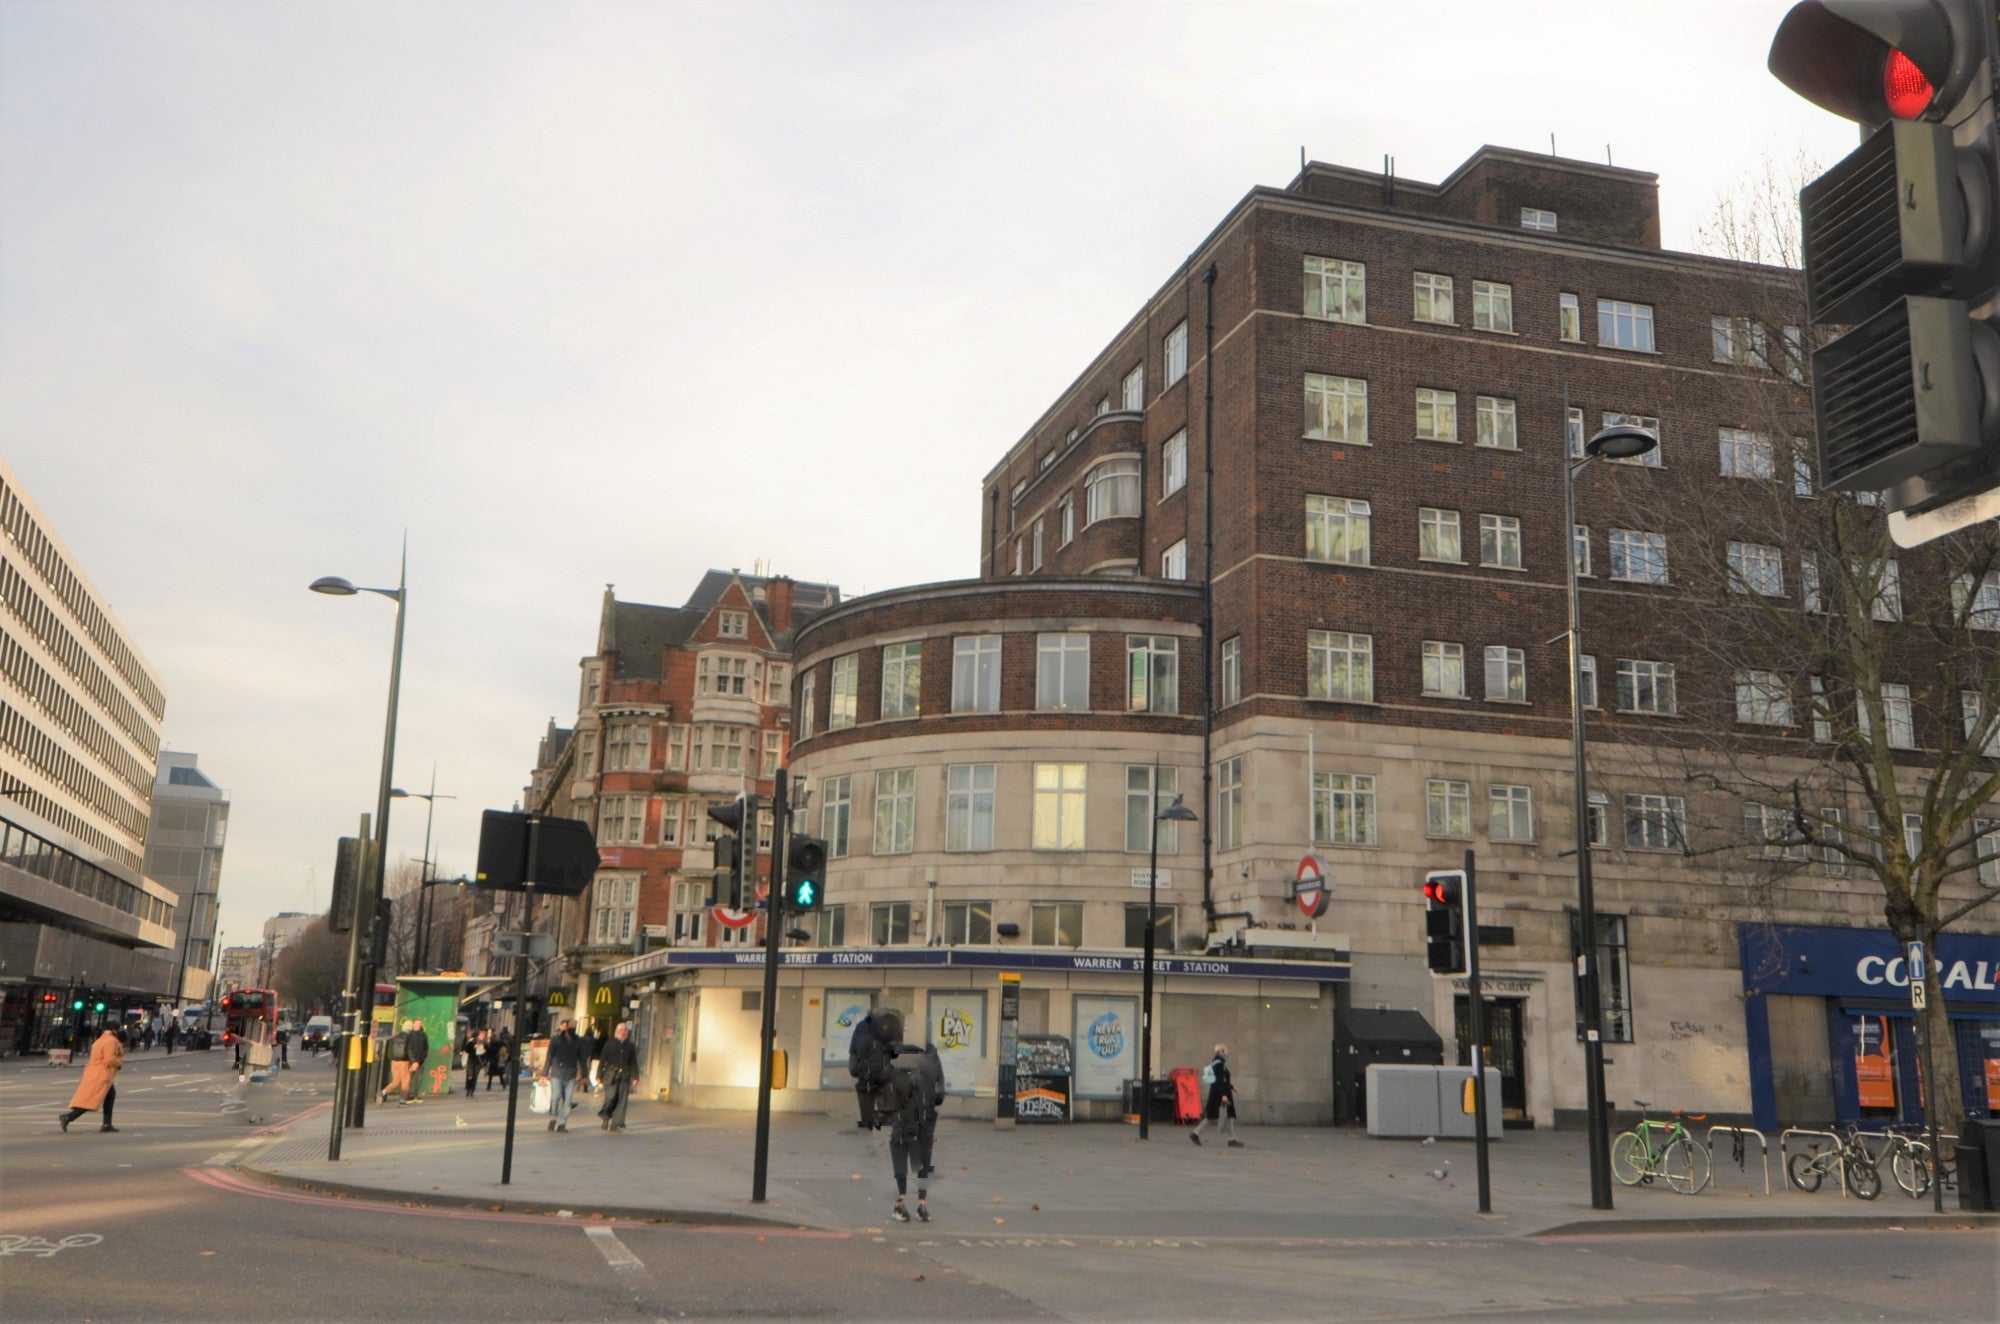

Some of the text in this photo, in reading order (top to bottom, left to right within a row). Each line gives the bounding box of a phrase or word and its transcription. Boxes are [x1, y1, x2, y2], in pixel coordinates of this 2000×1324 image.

[735, 953, 873, 964] WARRE STREET STATION
[1074, 957, 1229, 973] WARREN STEET STATION
[1451, 979, 1534, 992] WAEN COURT
[1913, 985, 1924, 1004] R
